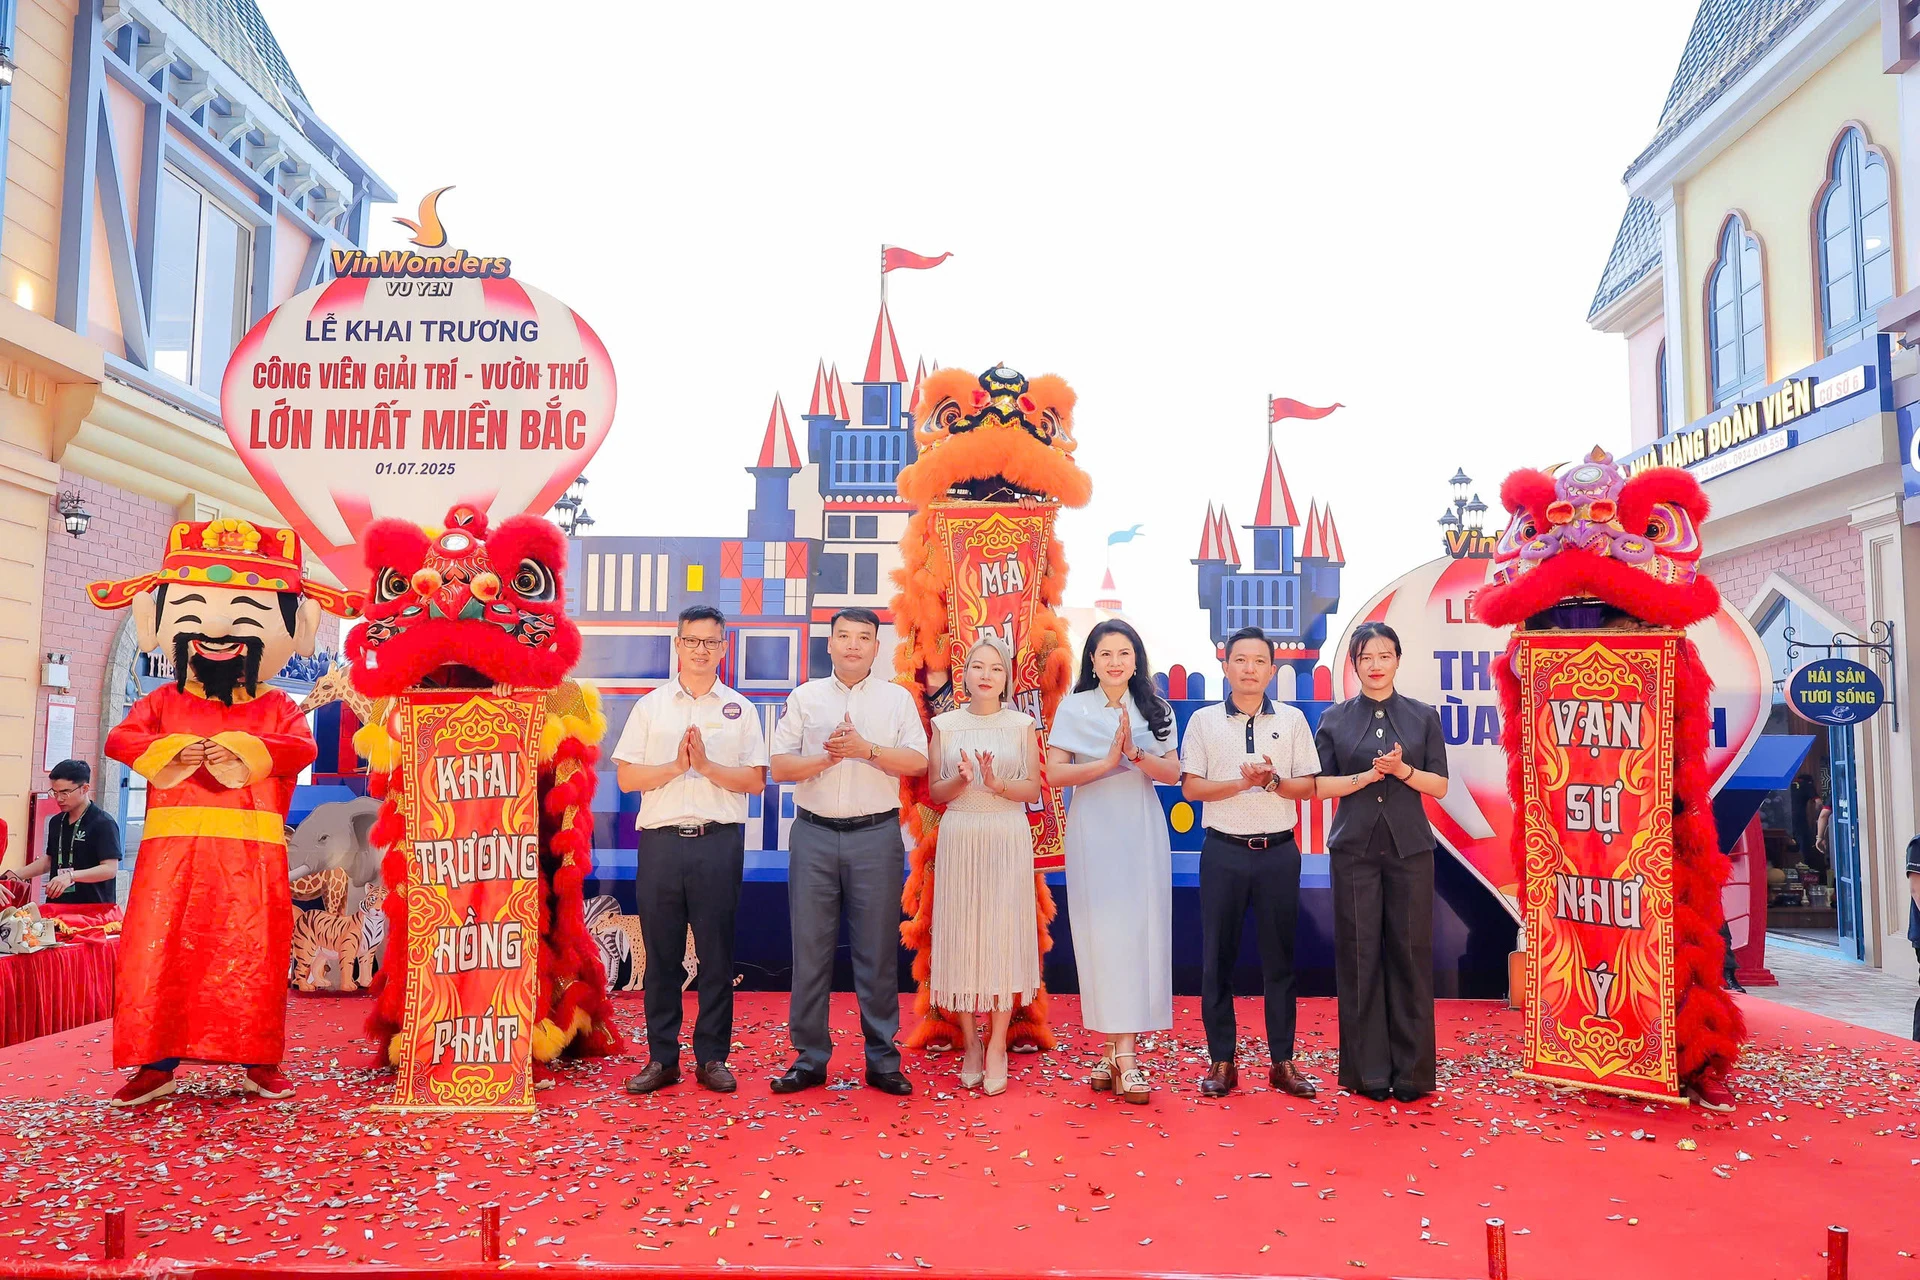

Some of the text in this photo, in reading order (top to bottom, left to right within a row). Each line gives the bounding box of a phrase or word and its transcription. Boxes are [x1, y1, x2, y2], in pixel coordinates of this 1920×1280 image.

[331, 250, 511, 278] VinWonders
[385, 281, 453, 297] VU YEN
[305, 312, 539, 342] LỄ KHAI TRƯƠNG
[252, 355, 311, 390] CÔNG
[319, 355, 367, 390] VIÊN
[374, 354, 417, 390] GIẢI
[424, 357, 459, 390] TRÍ
[481, 355, 540, 390] VƯỜN
[547, 356, 589, 390] THÚ
[249, 395, 587, 451] LỚN NHẤT MIỀN BẮC
[1662, 429, 1705, 469] HÀNG
[1708, 404, 1760, 454] ĐOÀN
[1762, 376, 1812, 430] VIÊN
[374, 461, 456, 476] 01.07.2025
[979, 552, 1024, 598] MÃ
[1800, 687, 1876, 704] TƯƠI SỐNG
[1807, 667, 1866, 684] HẢI SẢN
[1549, 700, 1644, 758] VẠN
[435, 751, 519, 803] KHAI
[1565, 779, 1624, 845] SỰ
[415, 829, 539, 890] TRƯƠNG
[1554, 872, 1646, 931] NHƯ
[434, 905, 522, 975] HỒNG
[1584, 962, 1619, 1021] Ý
[431, 1005, 519, 1066] PHÁT
